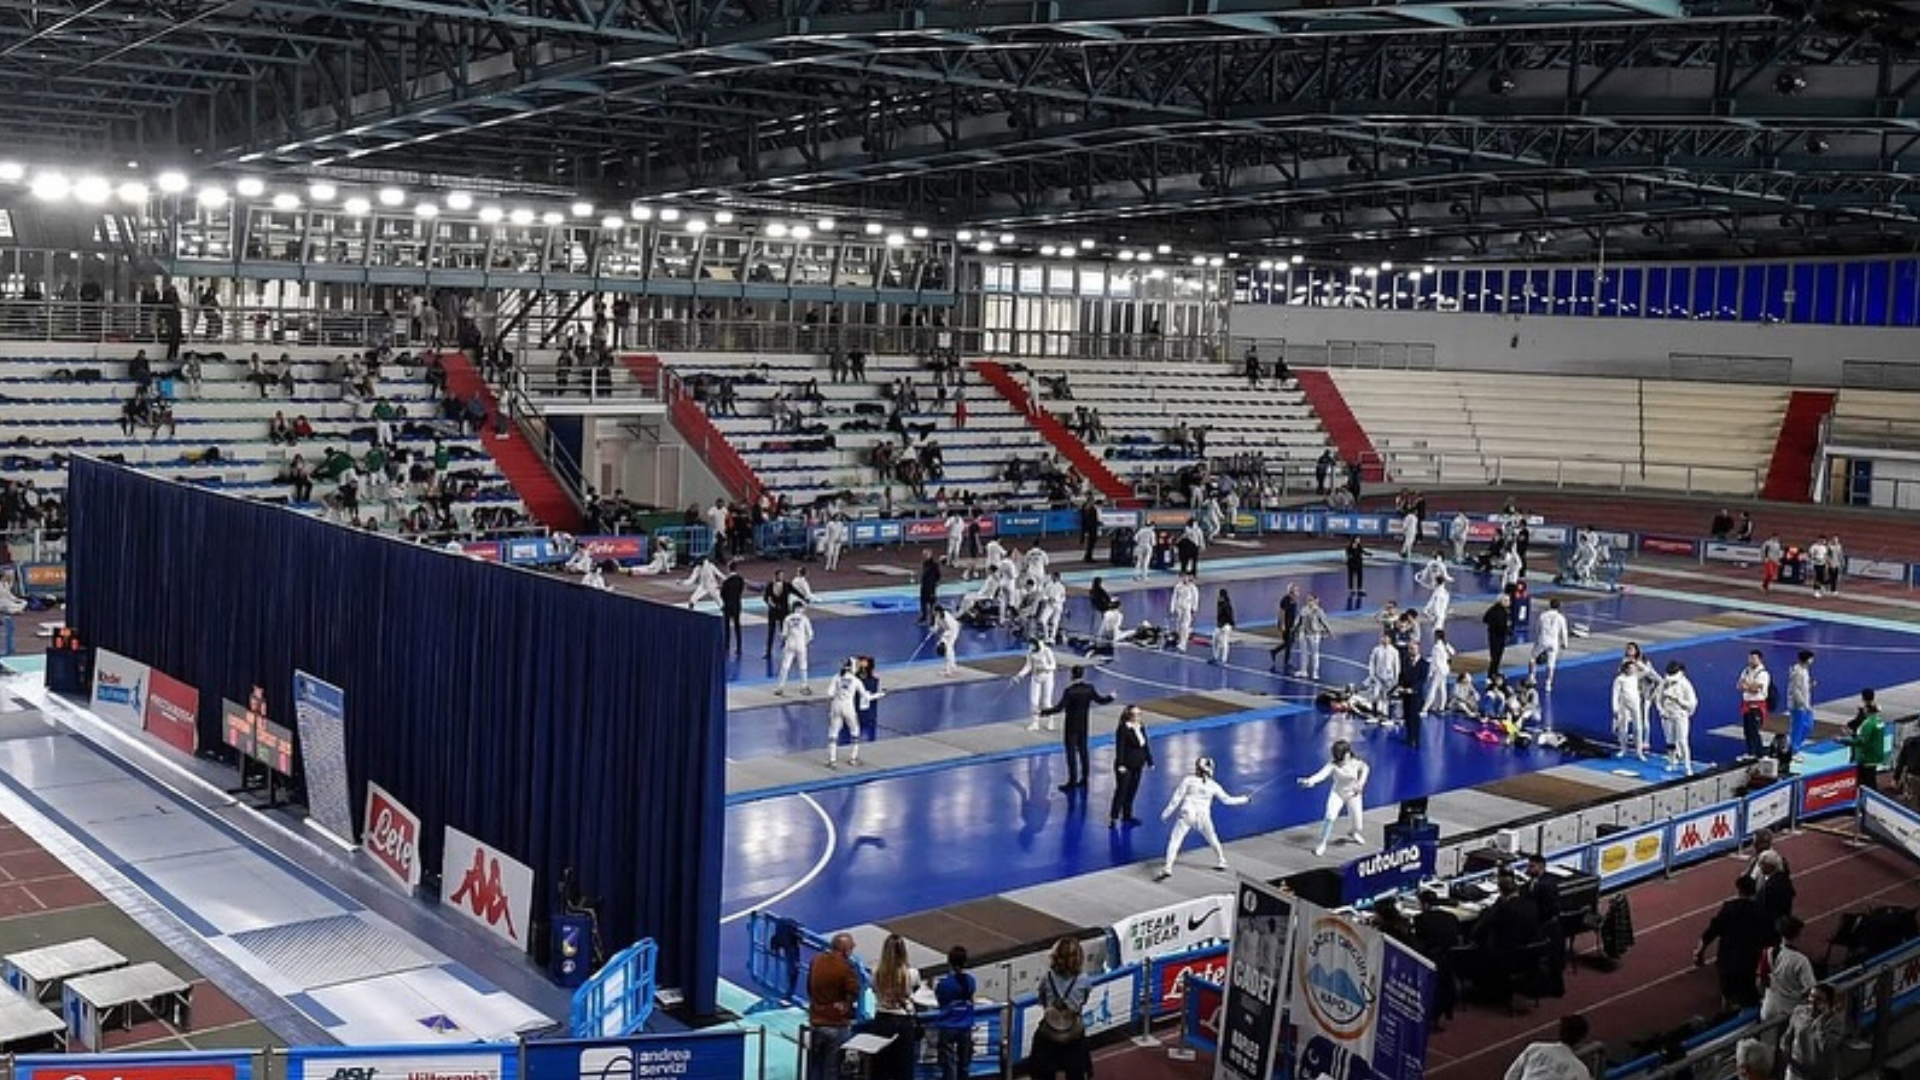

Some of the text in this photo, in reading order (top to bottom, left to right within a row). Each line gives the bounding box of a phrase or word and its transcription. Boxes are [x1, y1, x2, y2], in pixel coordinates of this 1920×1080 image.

[372, 808, 412, 870] Lete
[640, 1048, 692, 1062] andrea
[640, 1061, 688, 1076] servizi
